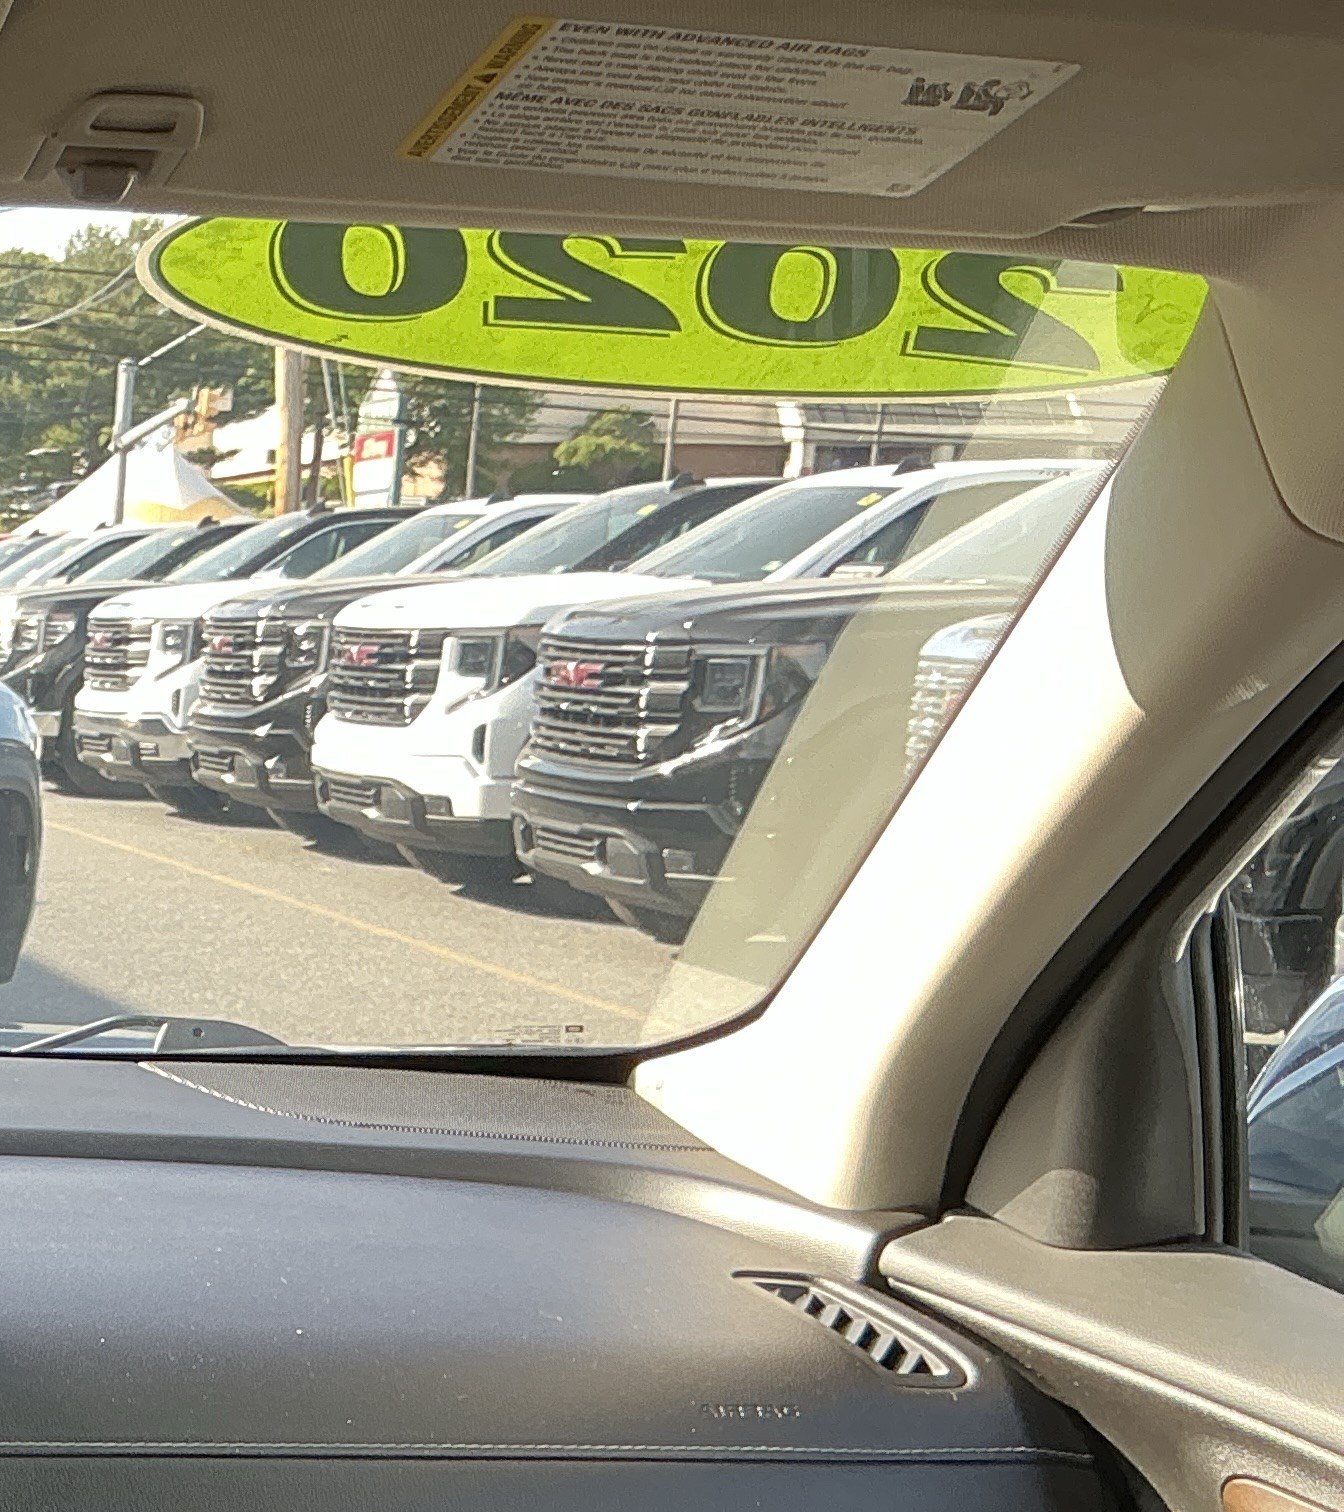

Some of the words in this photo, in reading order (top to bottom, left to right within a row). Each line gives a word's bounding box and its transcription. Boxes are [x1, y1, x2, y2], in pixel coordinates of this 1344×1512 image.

[558, 22, 611, 35] EVEN
[616, 27, 666, 40] WITH
[668, 31, 774, 50] ADVANCED
[775, 41, 813, 54] AIR
[815, 44, 870, 58] BAGS
